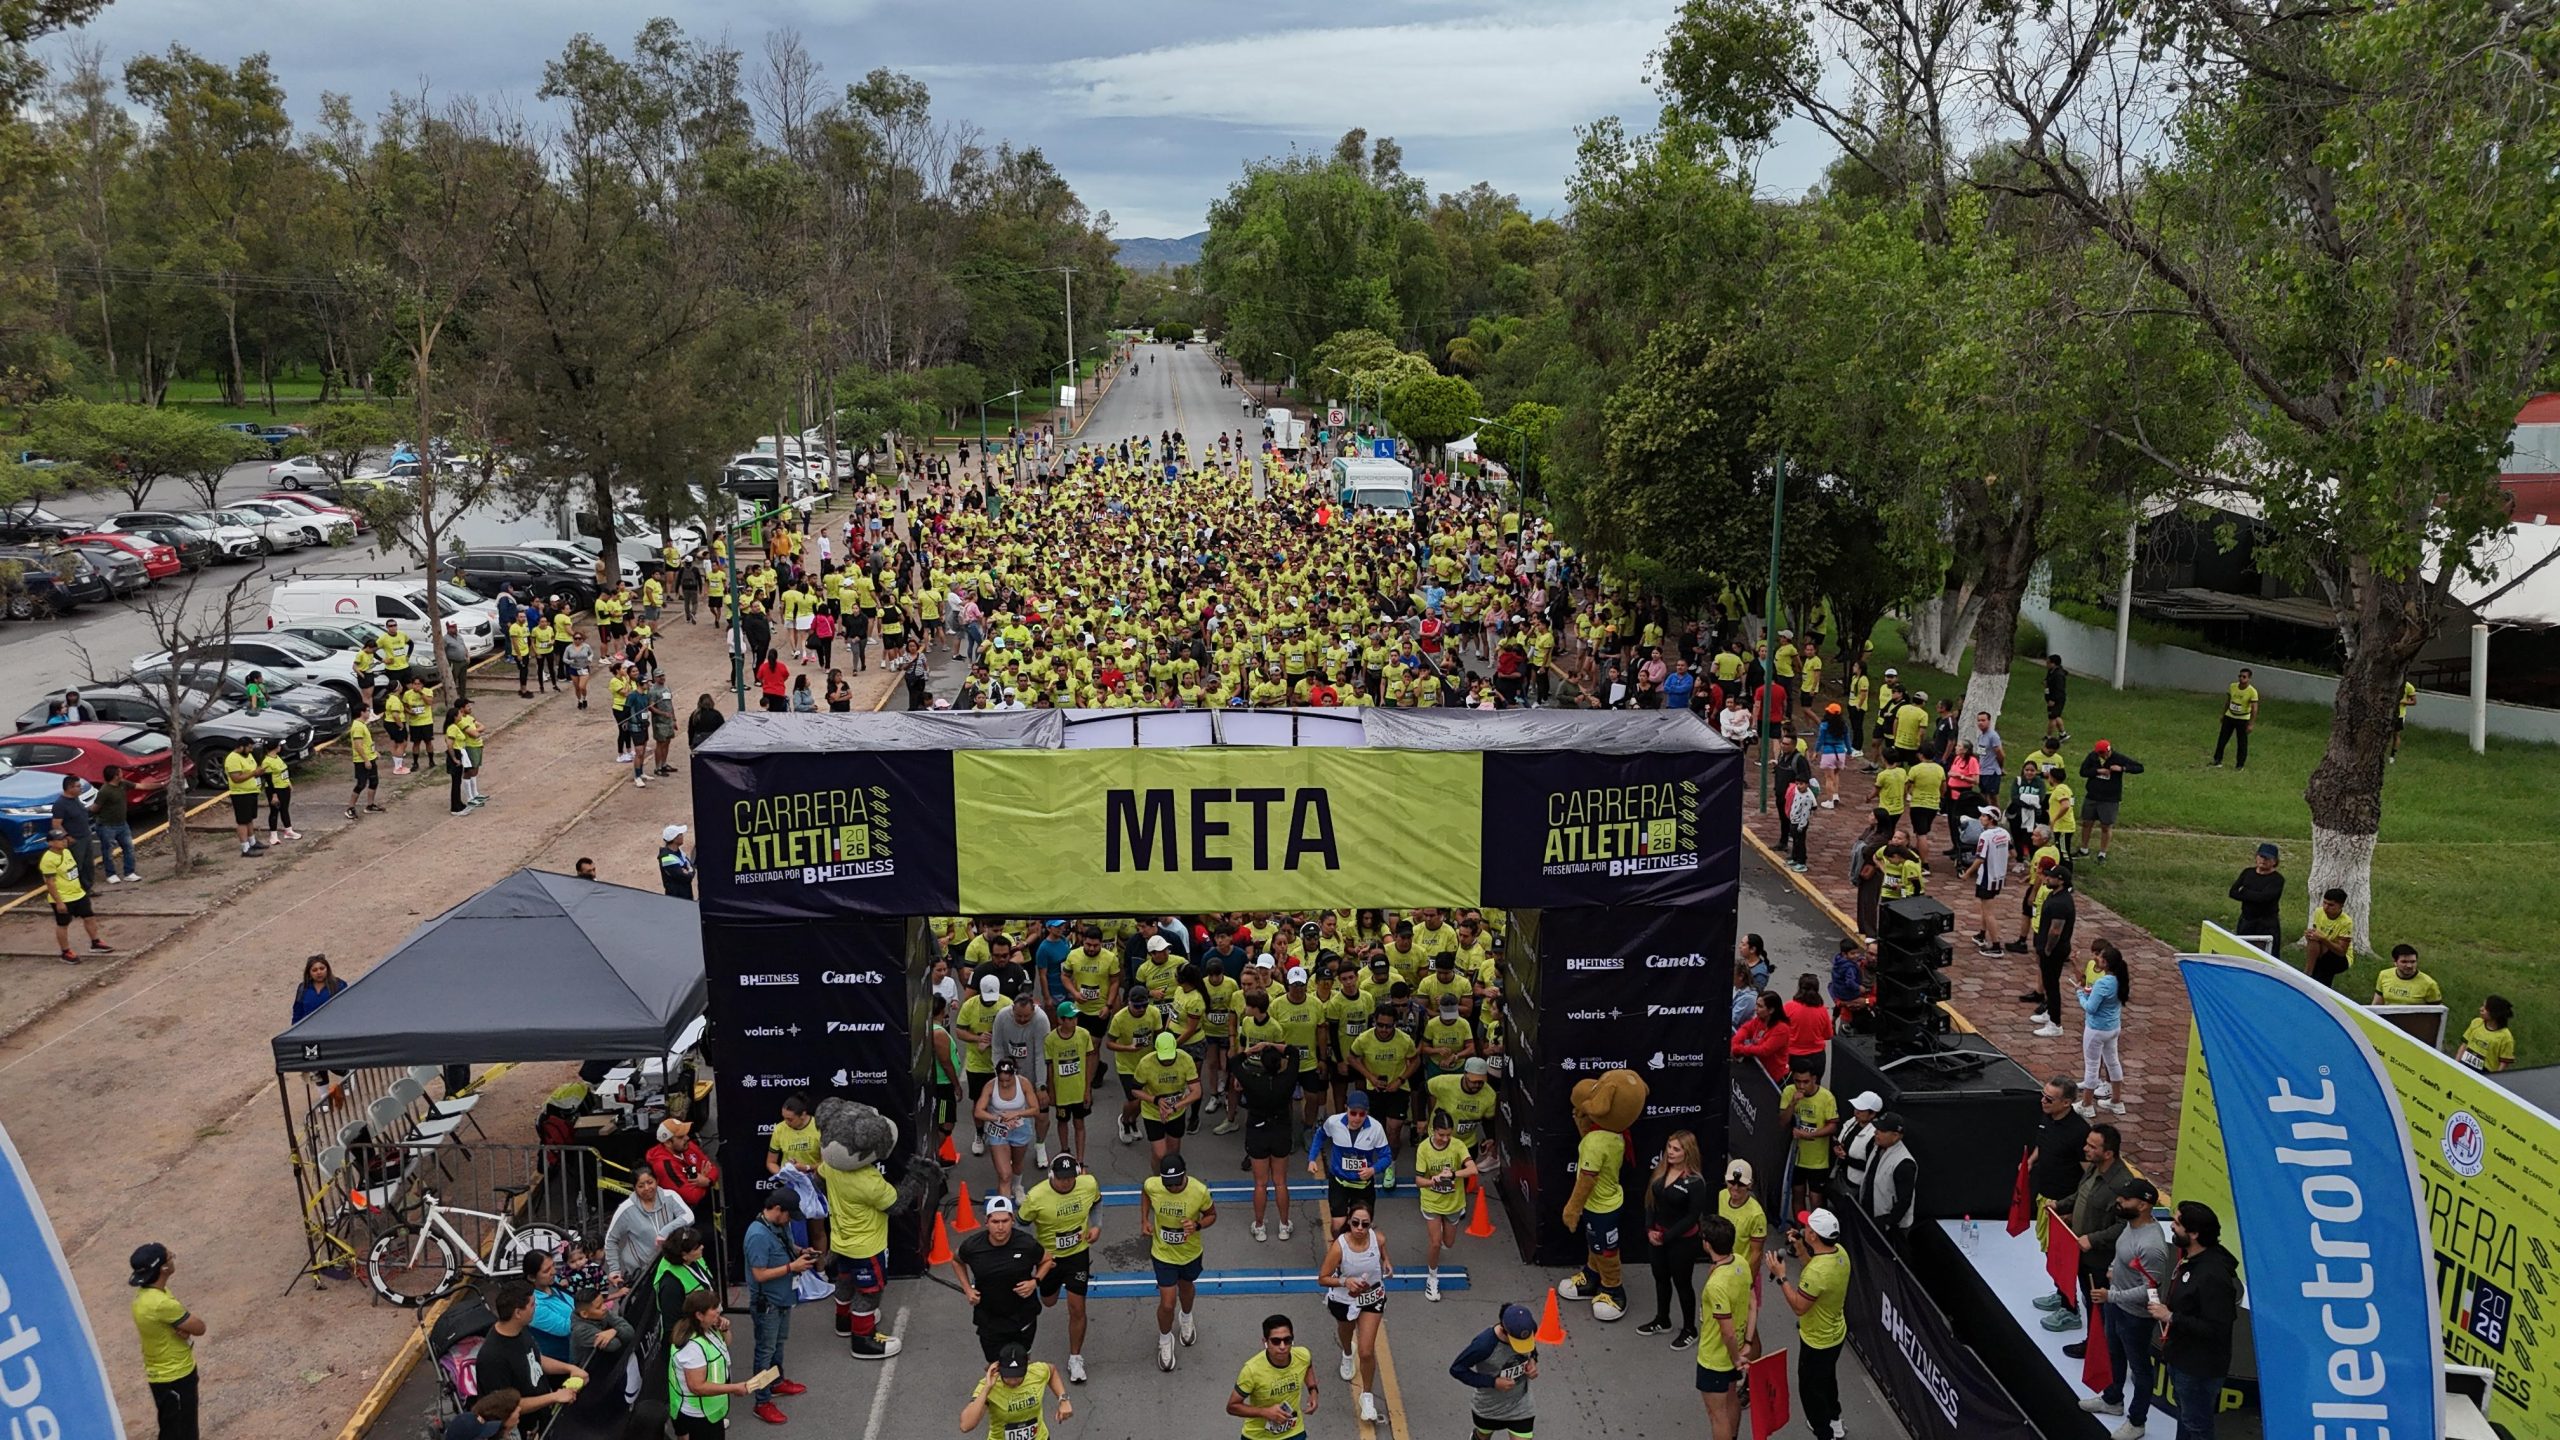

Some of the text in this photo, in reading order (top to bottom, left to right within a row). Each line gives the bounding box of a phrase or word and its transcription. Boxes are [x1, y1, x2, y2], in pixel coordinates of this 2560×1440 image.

[734, 787, 868, 835] CARRERA
[1548, 783, 1677, 826] CARRERA
[846, 828, 865, 843] 20
[1105, 787, 1340, 873] META
[1653, 822, 1672, 837] 20
[734, 827, 832, 872] ATLETI
[846, 843, 865, 857] 26
[1543, 821, 1640, 864] ATLETI
[1653, 837, 1671, 850] 26
[735, 858, 895, 885] PRESENTADA POR BHFITNESS
[1543, 852, 1698, 877] PRESENTADA POR BHFITNESS
[1566, 958, 1625, 970] BHFITNESS
[1645, 953, 1706, 968] Canel's
[739, 973, 800, 986] BHFITNESS
[821, 970, 884, 985] Canel's
[1567, 1009, 1606, 1020] volaris
[1659, 1005, 1704, 1015] DAIKIN
[744, 1026, 785, 1037] volaris
[839, 1023, 885, 1032] DAIKIN
[1667, 1053, 1704, 1061] Libertad
[1580, 1060, 1627, 1070] EL POTOSÍ
[761, 1076, 810, 1087] EL POTOSÍ
[851, 1070, 887, 1078] Libertad
[1657, 1105, 1702, 1114] CAFFENIO
[2444, 1148, 2457, 1167] SAN
[2461, 1165, 2477, 1175] LUIS
[1163, 1231, 1184, 1243] 0557
[2479, 1287, 2506, 1320] 20
[2475, 1312, 2502, 1345] 26
[1881, 1291, 1959, 1421] BHFITNESS
